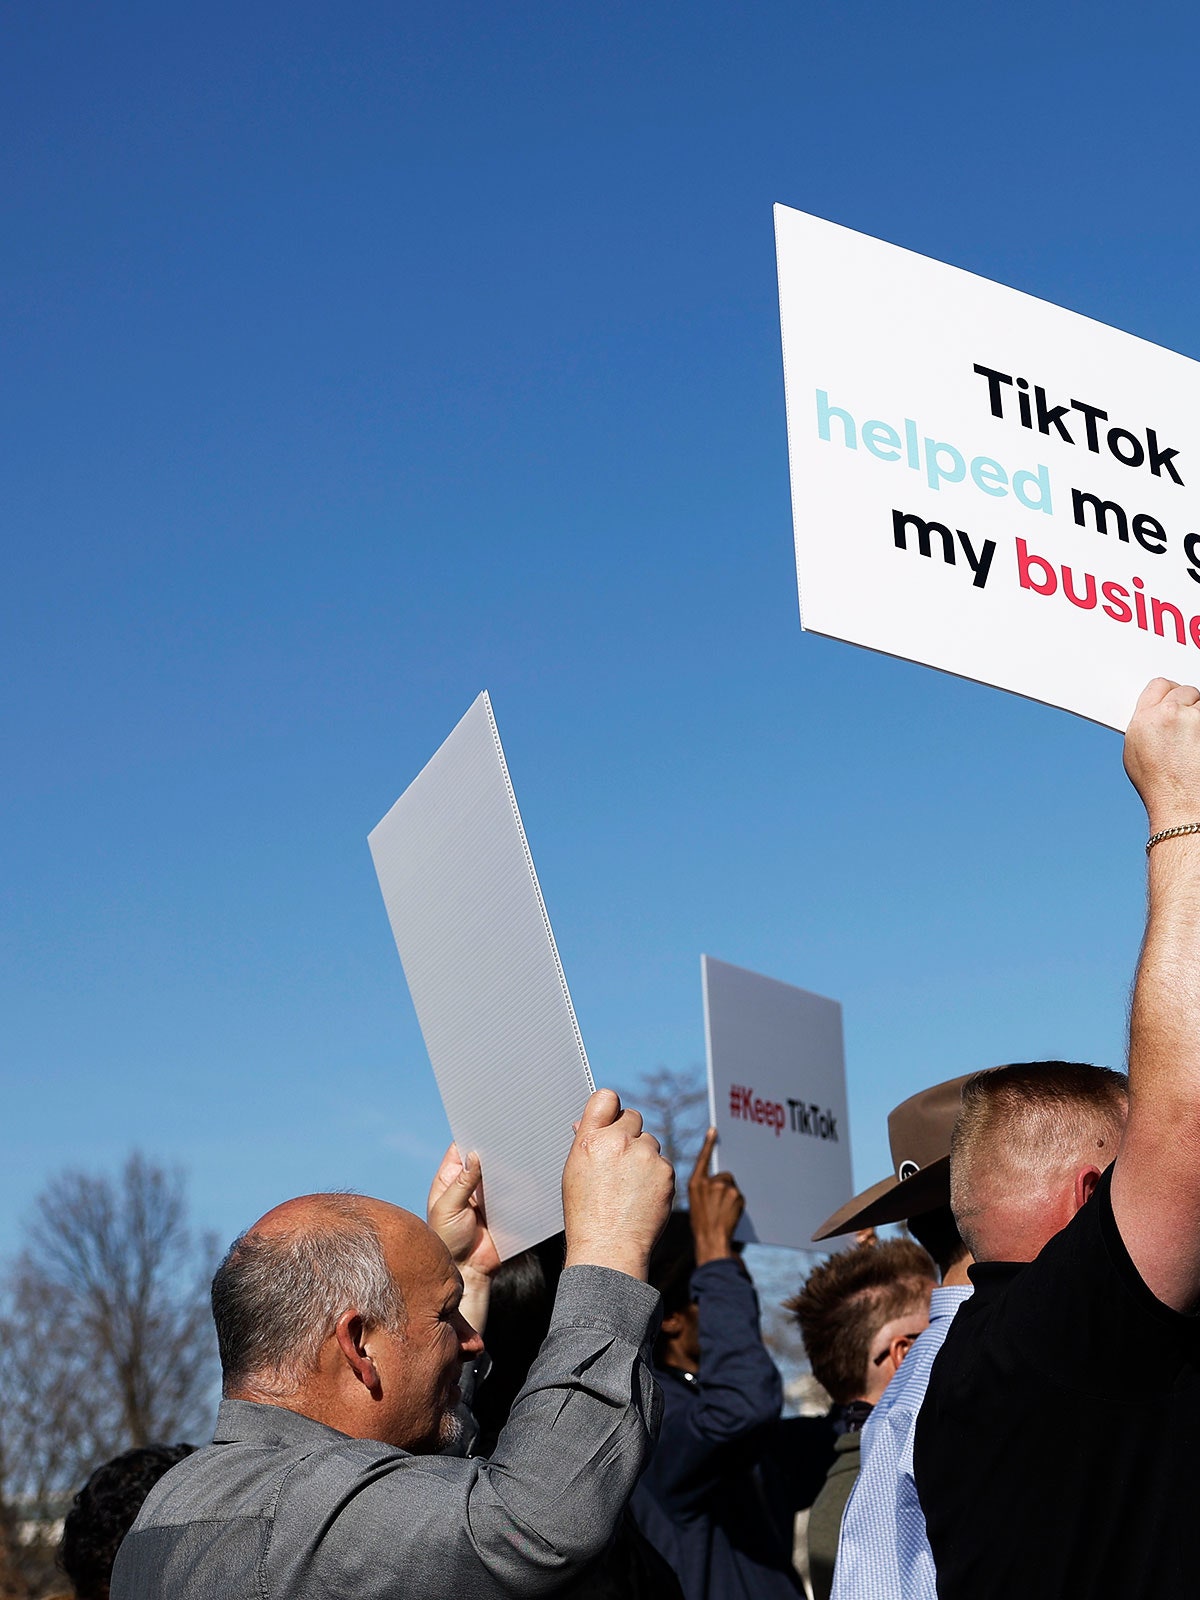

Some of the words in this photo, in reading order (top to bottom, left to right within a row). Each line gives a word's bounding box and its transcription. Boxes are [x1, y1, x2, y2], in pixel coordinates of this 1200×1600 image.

[816, 389, 1053, 515] helped
[1071, 488, 1167, 555] me
[973, 363, 1185, 487] TikTok
[892, 509, 997, 590] my
[729, 1085, 786, 1136] #Keep
[787, 1099, 839, 1142] TikTok
